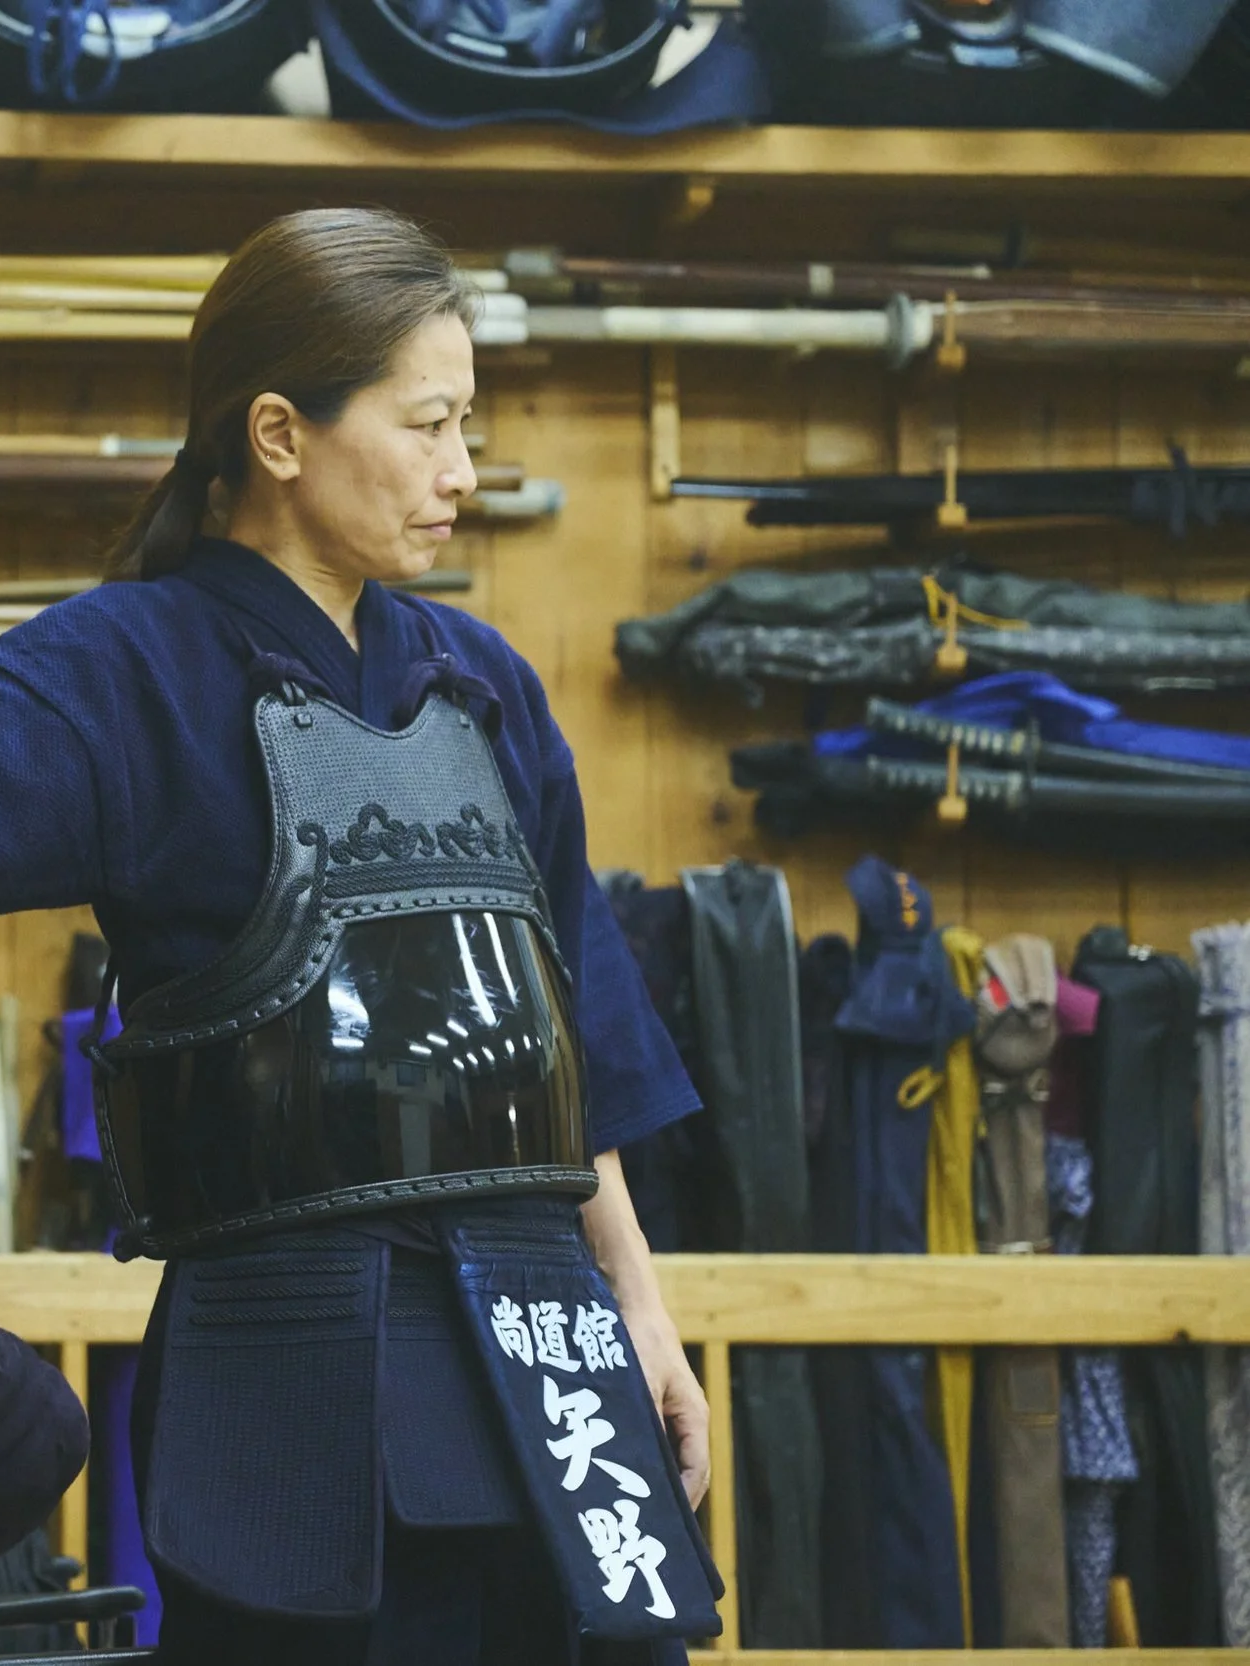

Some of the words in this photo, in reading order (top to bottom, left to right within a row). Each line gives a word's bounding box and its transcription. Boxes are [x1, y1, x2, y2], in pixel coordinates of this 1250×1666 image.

[491, 1294, 629, 1374] 尚道館
[543, 1374, 677, 1620] 矢野
